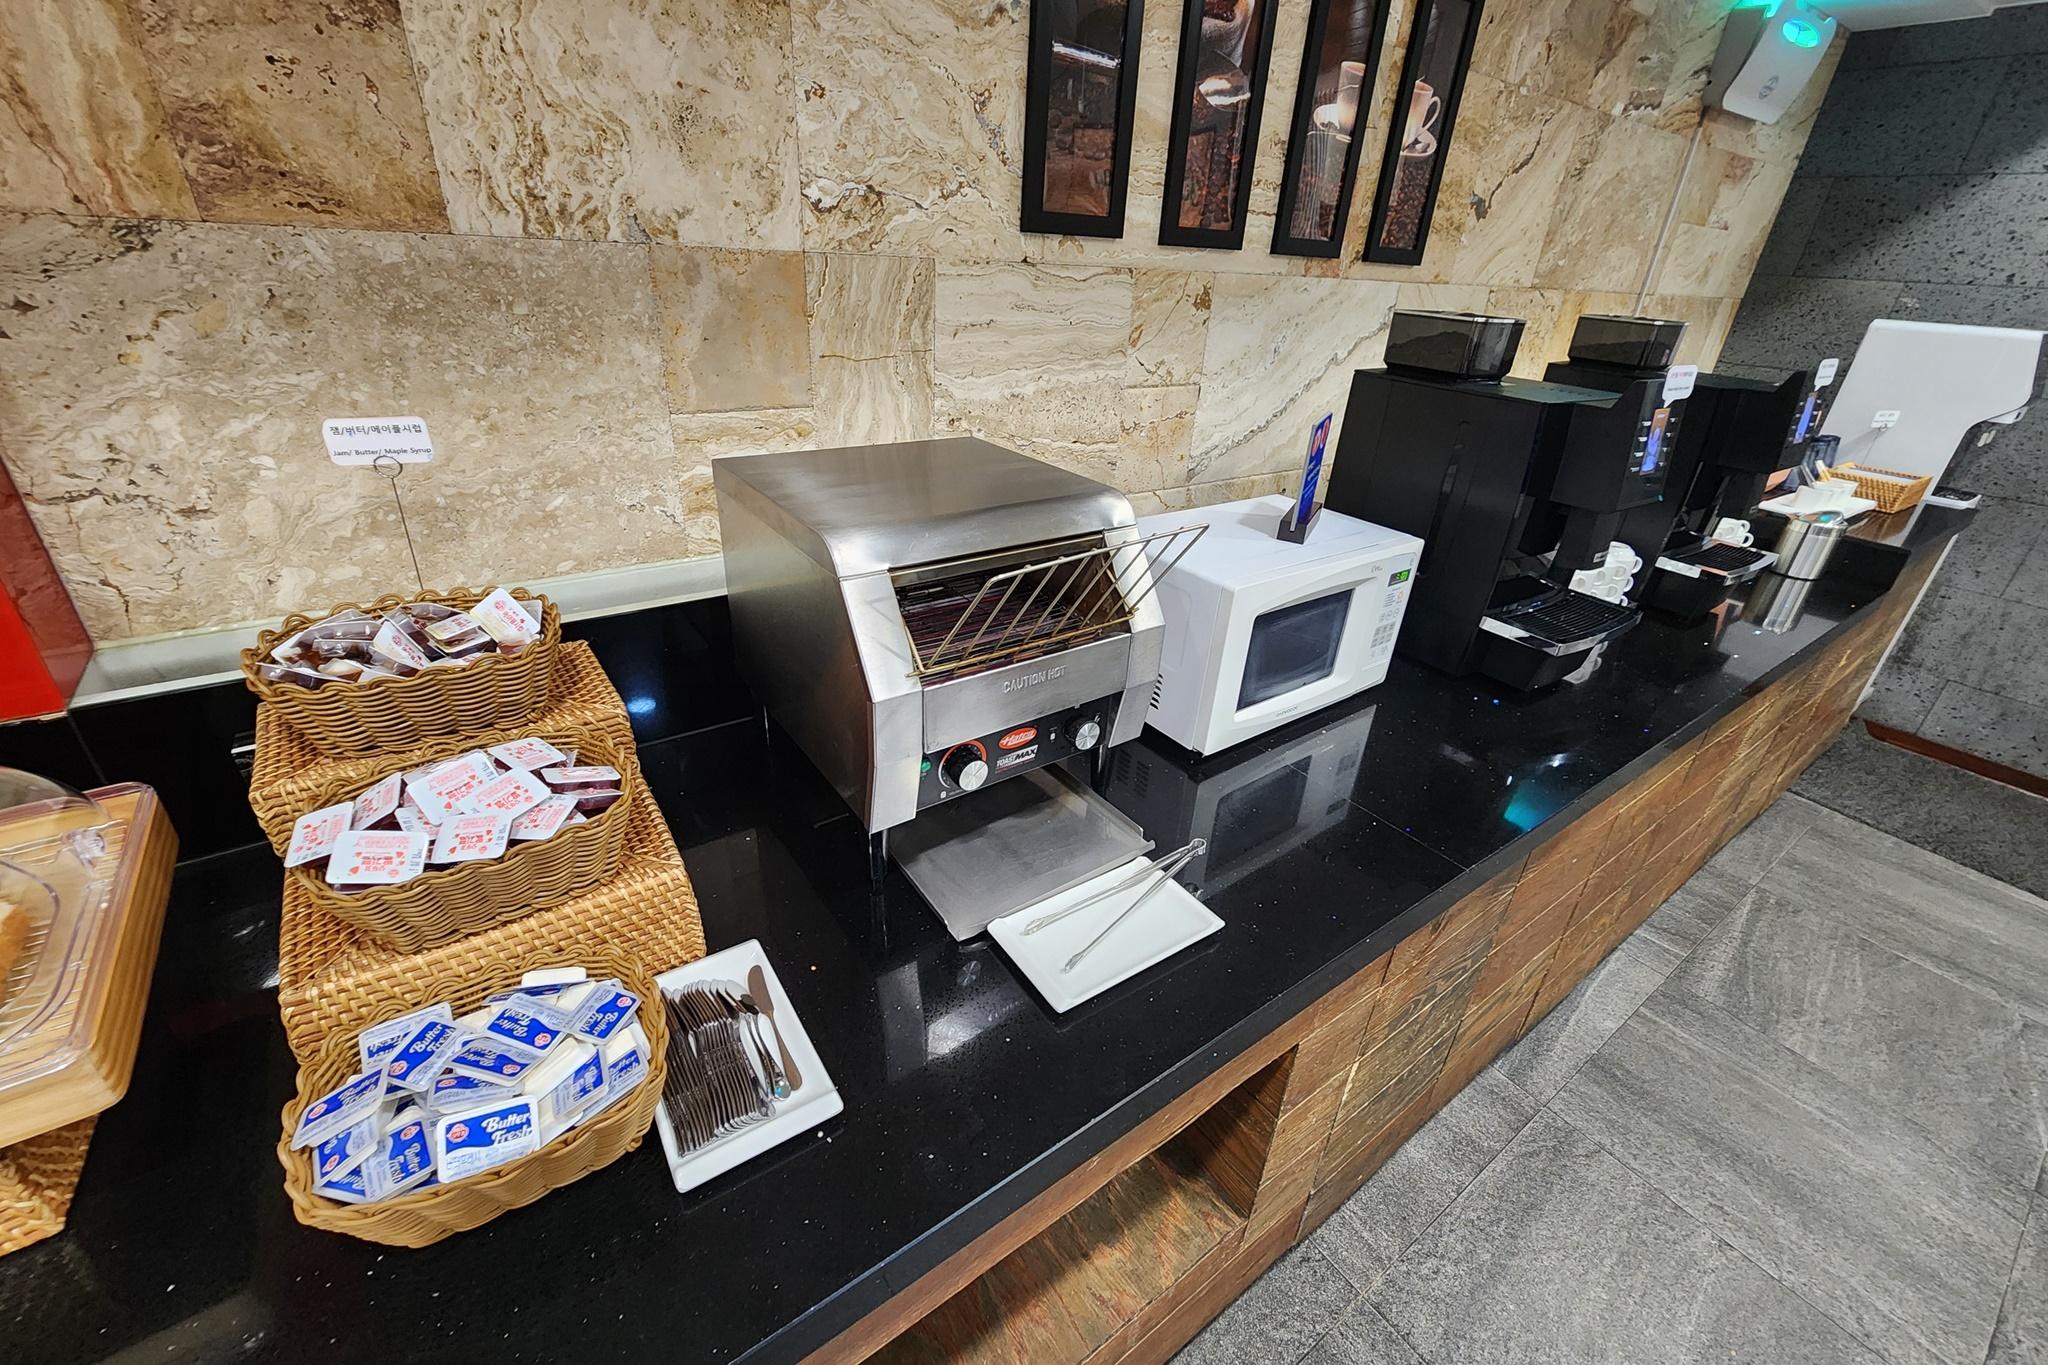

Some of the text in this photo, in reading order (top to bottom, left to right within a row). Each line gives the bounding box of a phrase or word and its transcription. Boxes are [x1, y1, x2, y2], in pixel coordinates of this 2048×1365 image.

[355, 448, 381, 456] Butter/
[384, 447, 408, 455] Maple
[410, 447, 432, 455] Syrup
[1003, 665, 1067, 694] CAUTION HOT
[503, 1007, 532, 1026] Fresh
[580, 1012, 604, 1032] Fresh
[593, 1012, 619, 1036] Butter
[409, 1023, 444, 1053] Butter
[495, 1019, 529, 1037] Butter
[426, 1027, 456, 1052] Fresh
[461, 1051, 496, 1066] Butter
[481, 1112, 531, 1133] Butter
[491, 1124, 533, 1145] Fresh
[404, 1142, 421, 1173] Butter
[388, 1155, 406, 1184] Fresh
